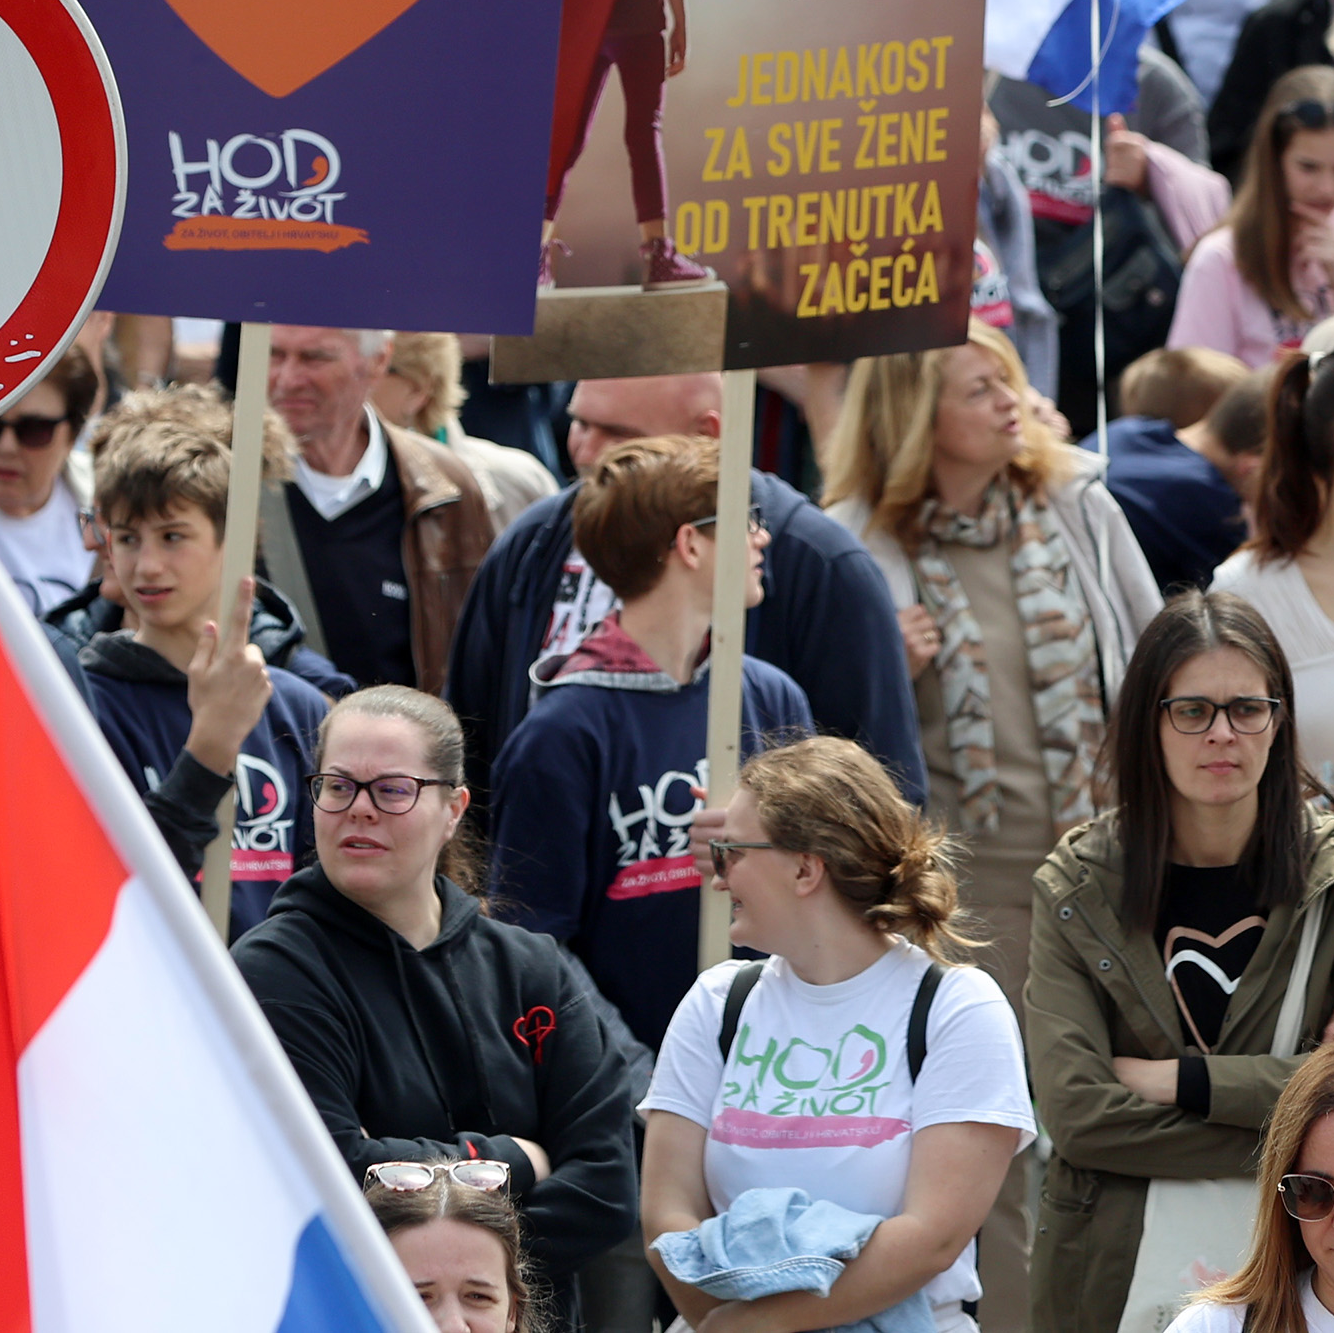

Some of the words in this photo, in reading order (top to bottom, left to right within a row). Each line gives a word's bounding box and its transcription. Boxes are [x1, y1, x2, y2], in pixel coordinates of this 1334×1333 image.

[726, 36, 953, 108] JEDNAKOST
[168, 128, 341, 197] HOD
[701, 127, 752, 182] ZA
[767, 118, 843, 177] SVE
[854, 99, 949, 170] ŽENE
[172, 184, 224, 218] ZA
[232, 188, 347, 225] ŽIVOT
[675, 200, 730, 256] OD
[743, 179, 944, 252] TRENUTKA
[796, 238, 940, 318] ZAČEĆA
[616, 828, 663, 867] ZA
[734, 1022, 888, 1092] HOD
[723, 1078, 761, 1109] ZA
[770, 1080, 892, 1117] ŽIVOT
